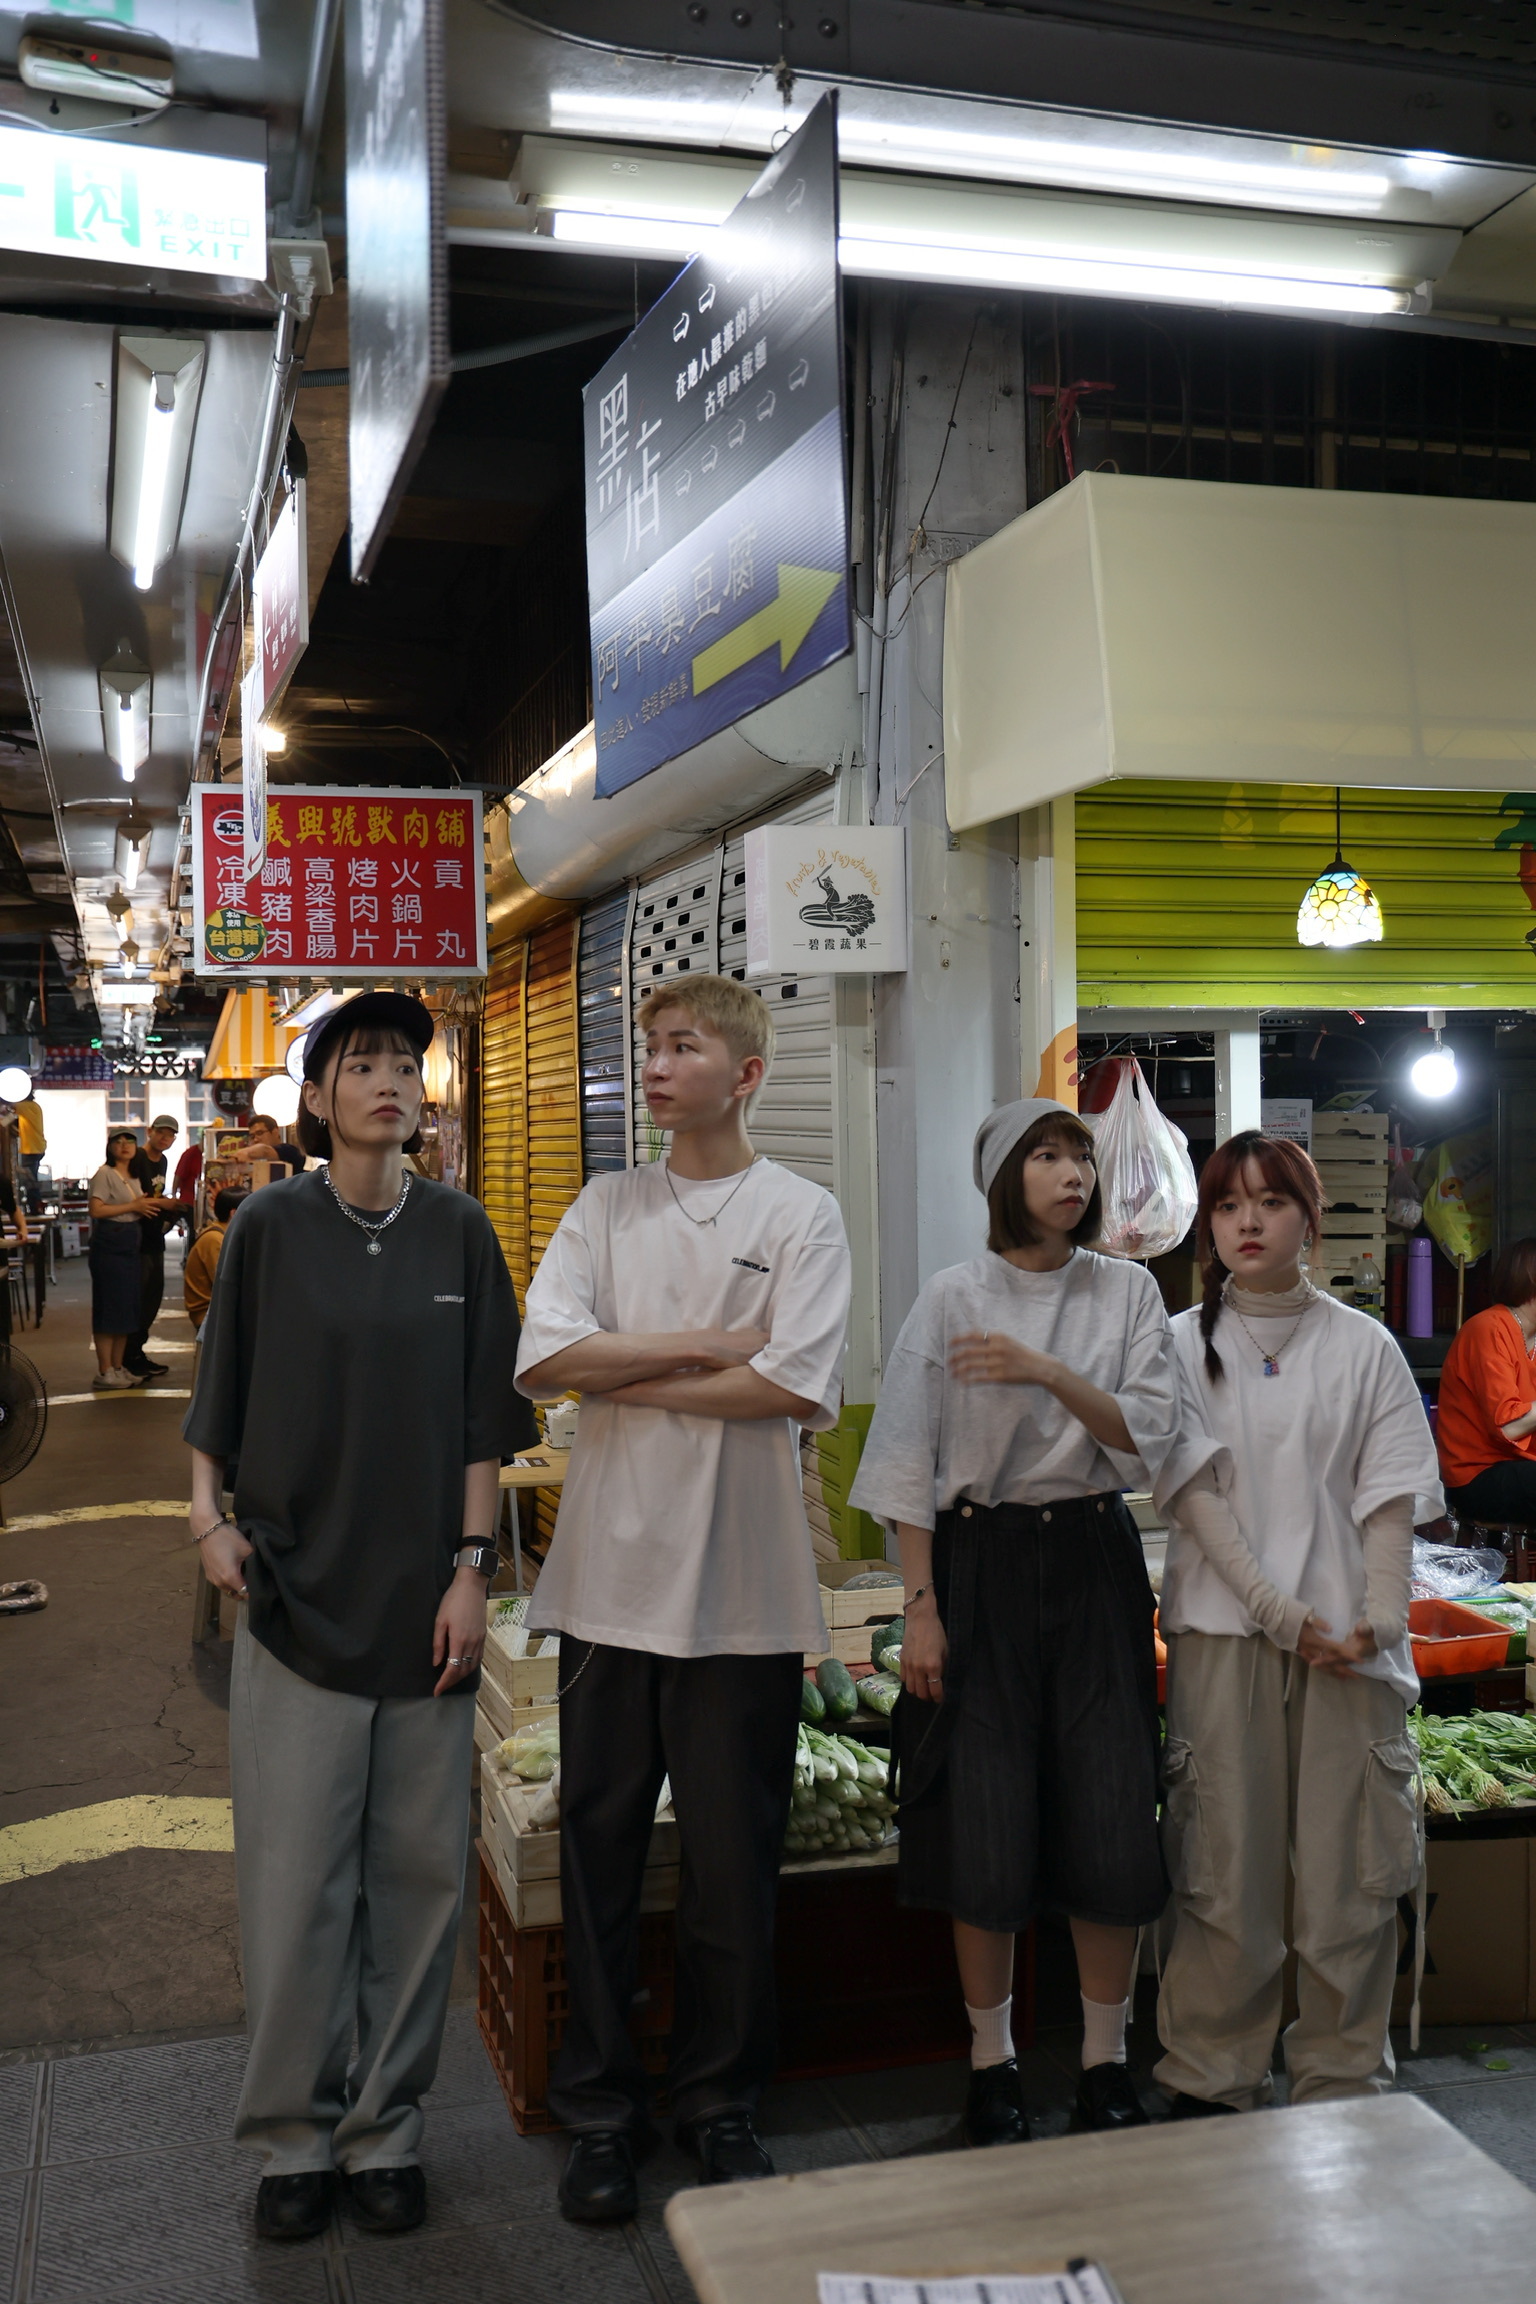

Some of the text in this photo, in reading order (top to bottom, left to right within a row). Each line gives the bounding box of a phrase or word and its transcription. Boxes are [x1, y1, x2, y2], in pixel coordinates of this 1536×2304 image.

[160, 234, 244, 261] EXIT
[597, 522, 758, 702] 阿平臭豆腐
[209, 929, 259, 946] 台灣豬
[261, 856, 293, 959] 鹹豬肉
[347, 857, 380, 960] 烤肉片
[391, 857, 423, 960] 火鍋片
[433, 859, 466, 960] 貢丸
[808, 938, 868, 951] 碧霞蔬果
